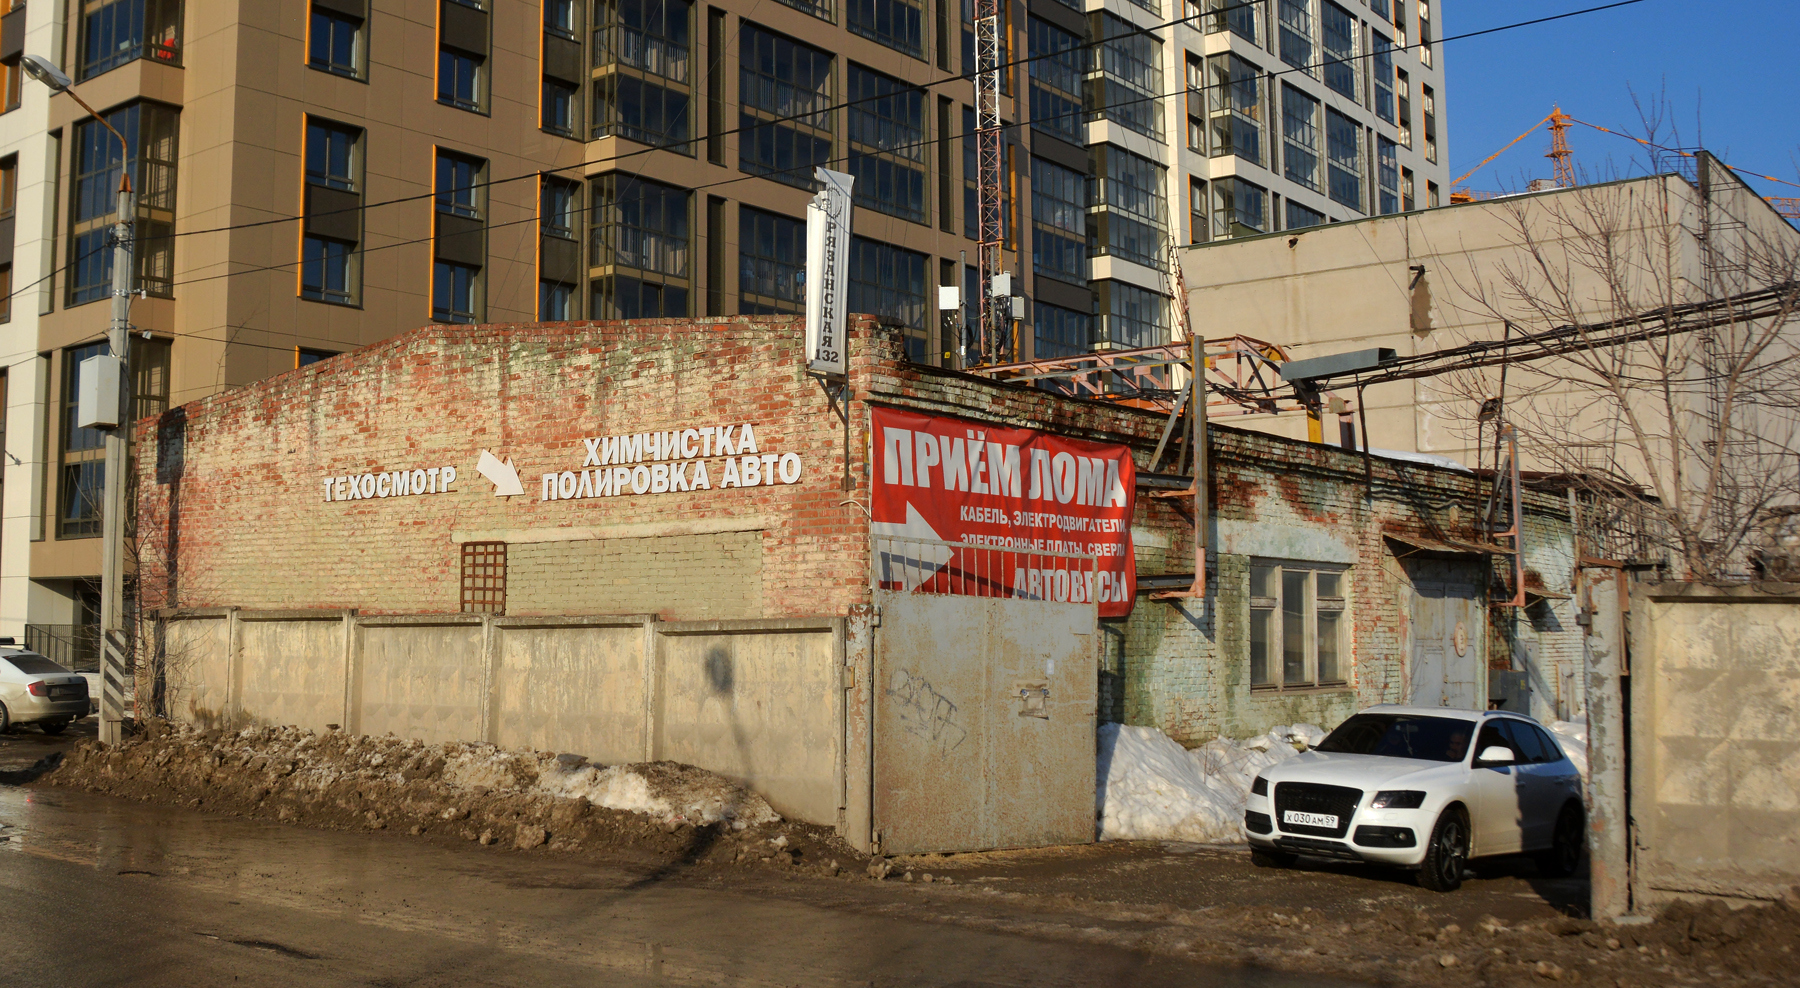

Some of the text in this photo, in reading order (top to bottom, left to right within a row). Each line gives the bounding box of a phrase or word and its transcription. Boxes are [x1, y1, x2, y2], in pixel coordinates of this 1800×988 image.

[822, 221, 837, 348] РЯЗАНСКАЯ
[815, 348, 839, 363] 132
[582, 423, 759, 467] ХИМЧИСТКА
[323, 466, 457, 502] ТЕХОСМОТР
[541, 452, 803, 501] ПОЛИРОВКА АВТО
[883, 426, 1128, 508] ПРИЁМ ЛОМА
[960, 505, 1127, 535] КАБЕЛЬ, ЭЛЕКТРОДВИГАТЕЛИ,
[960, 533, 1045, 551] ЭЛЕКТРОННЫЕ
[1087, 542, 1126, 557] СВЕРЛА
[1012, 567, 1129, 603] АВТОВЕСЫ
[1325, 815, 1336, 824] 59
